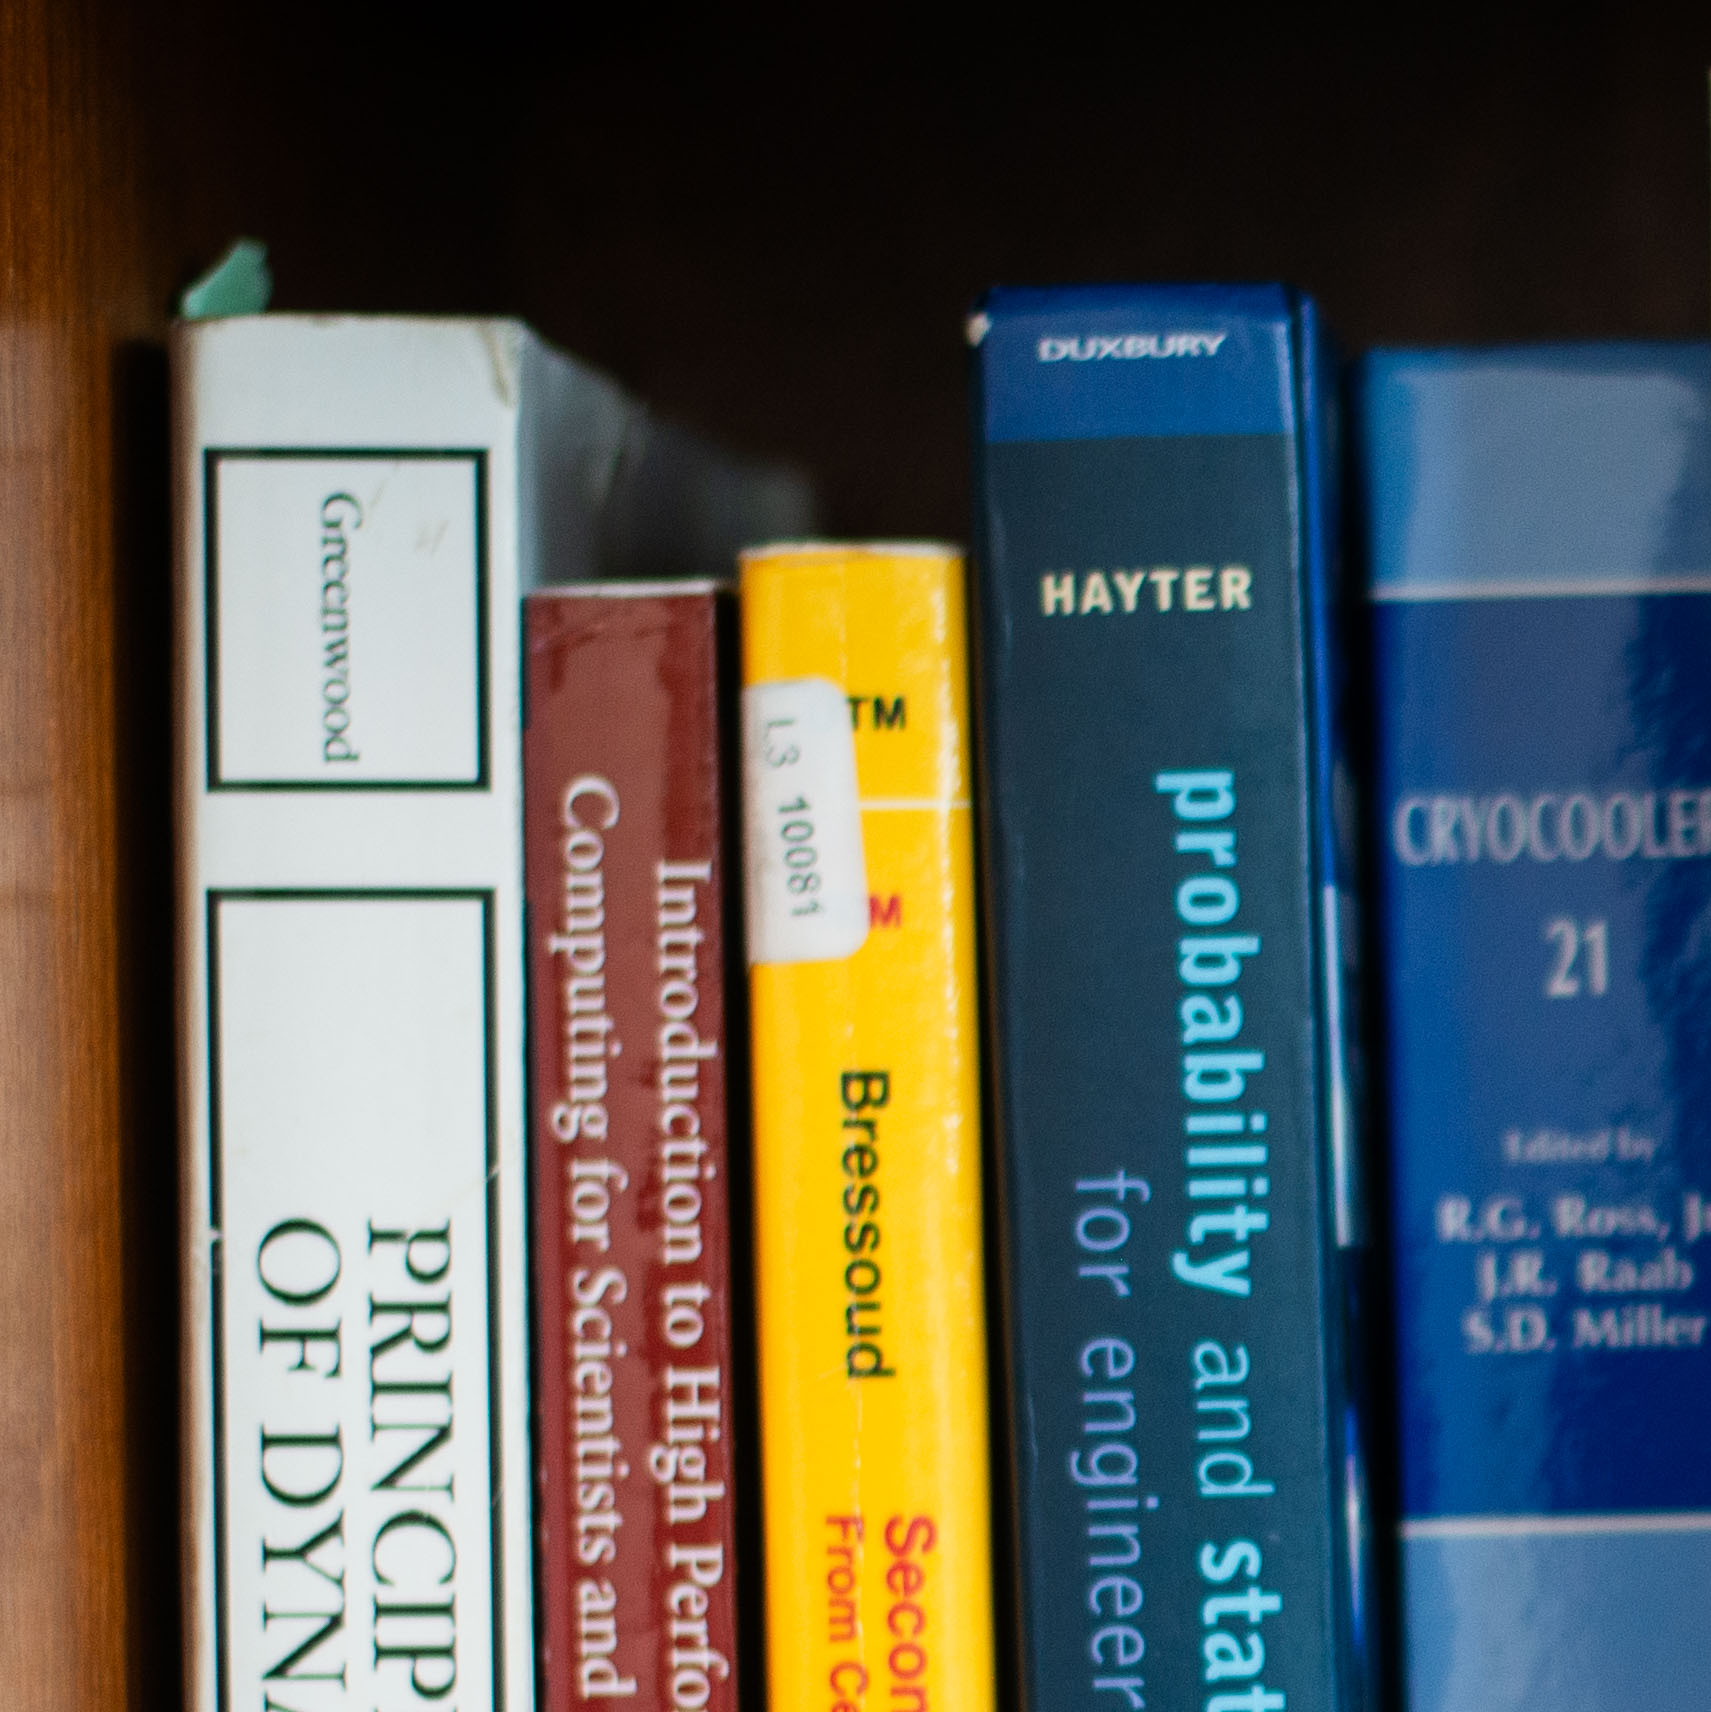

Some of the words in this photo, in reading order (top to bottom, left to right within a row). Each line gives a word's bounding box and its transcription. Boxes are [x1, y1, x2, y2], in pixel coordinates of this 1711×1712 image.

[1037, 331, 1228, 363] DUXBURY
[321, 492, 362, 765] Greenwood
[1041, 567, 1252, 616] HAYTER
[778, 797, 823, 918] 10081
[551, 774, 624, 1141] Computing
[1546, 917, 1608, 998] 21
[657, 859, 718, 1263] Introduction
[1154, 769, 1273, 1298] probability
[572, 1158, 628, 1252] for
[841, 1071, 896, 1379] Bressoud
[1075, 1171, 1152, 1297] for
[1437, 1194, 1540, 1241] R.G.
[255, 1217, 342, 1380] OF
[667, 1287, 706, 1346] to
[1462, 1304, 1556, 1354] S.D.
[1573, 1304, 1706, 1349] Miller
[570, 1270, 627, 1563] Scientists
[650, 1366, 724, 1522] High
[1193, 1339, 1275, 1498] and
[578, 1582, 636, 1698] and
[826, 1516, 865, 1645] From
